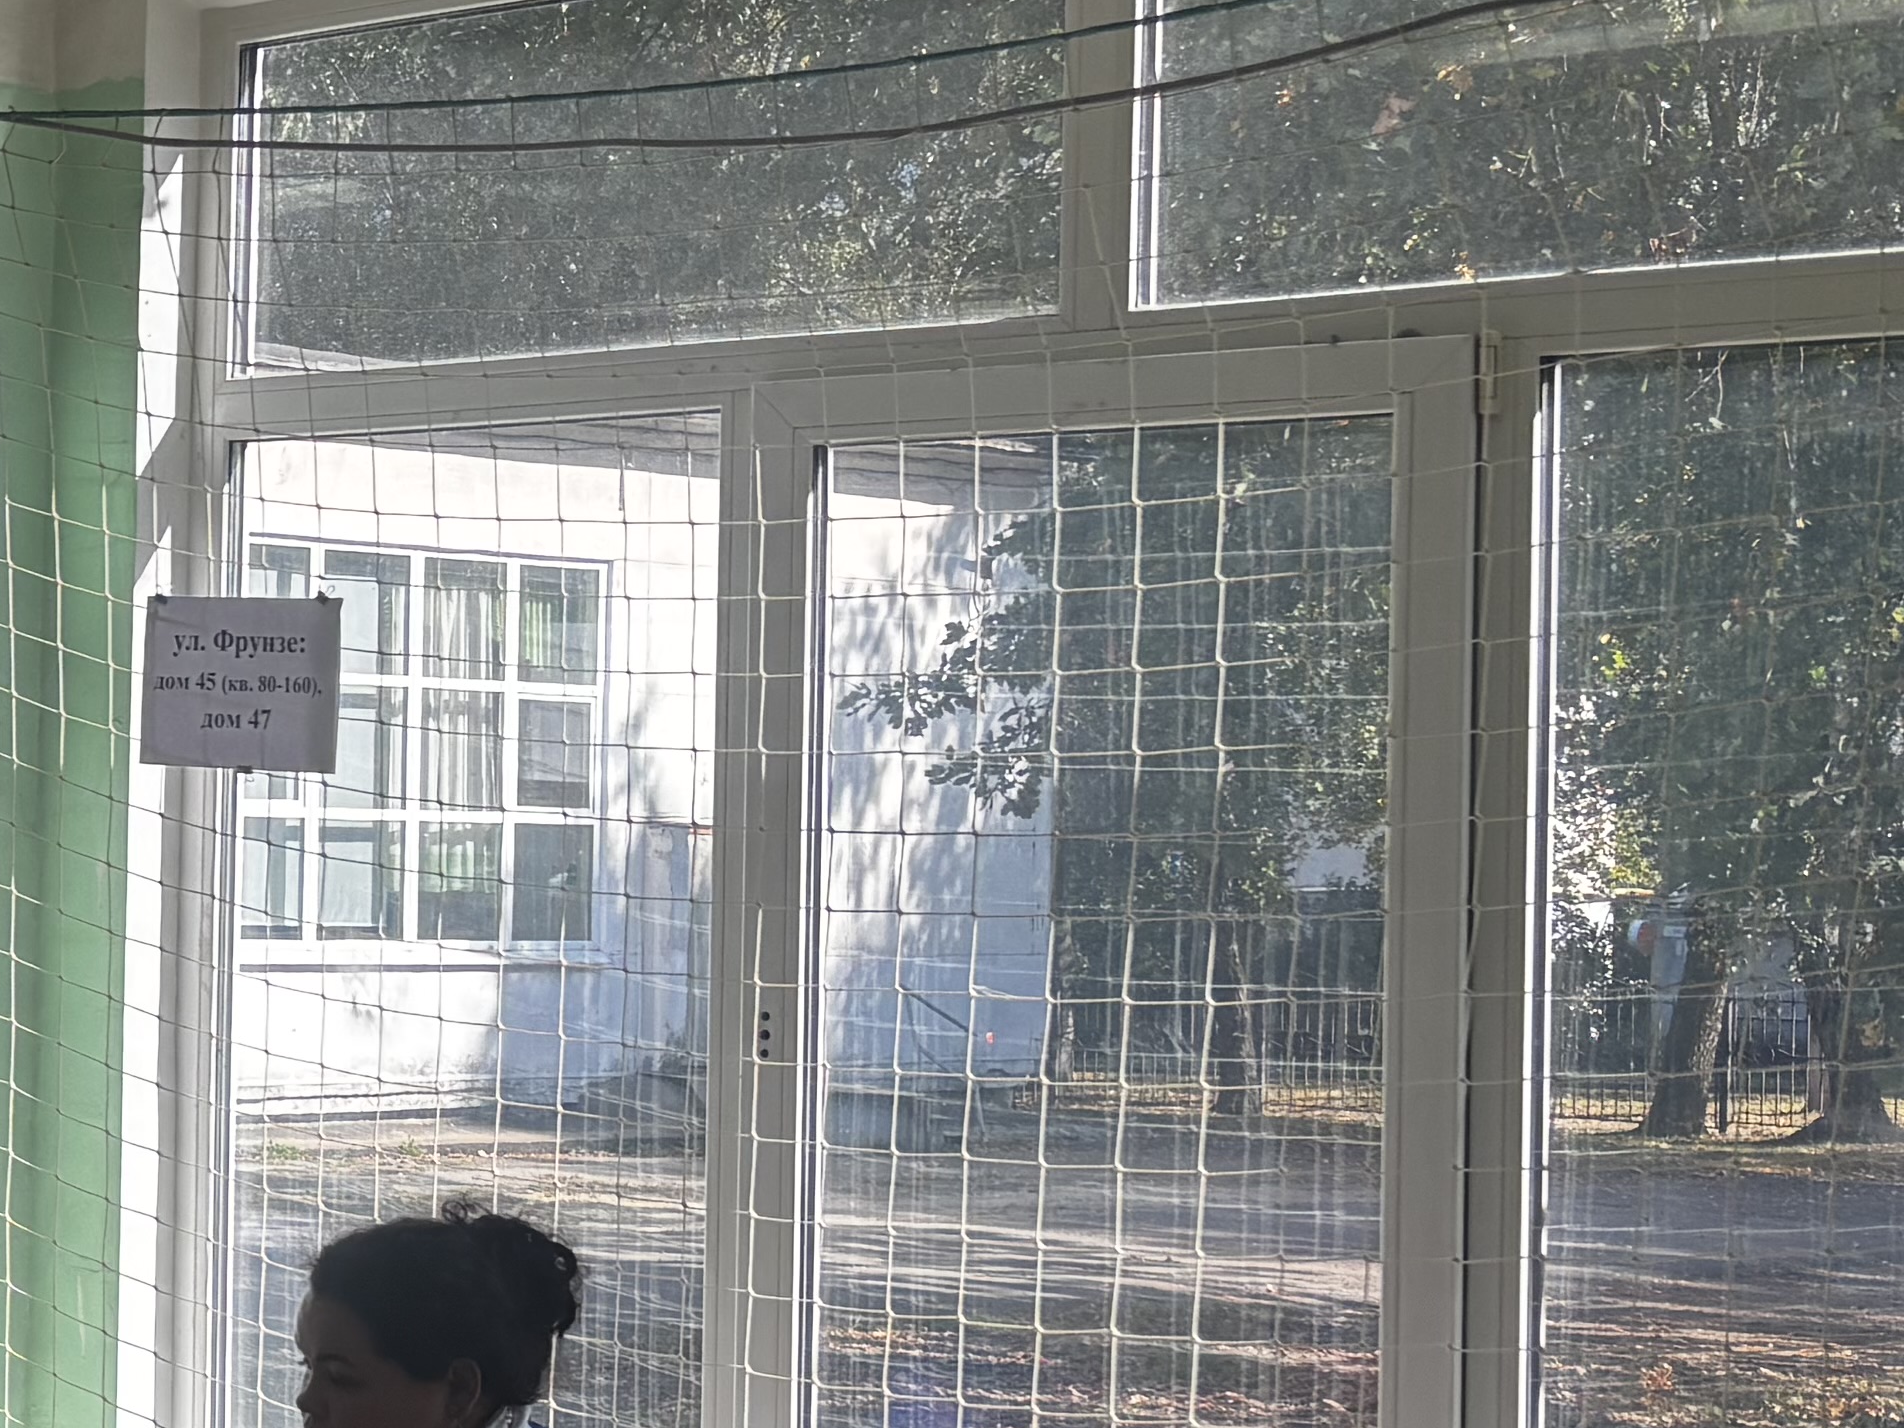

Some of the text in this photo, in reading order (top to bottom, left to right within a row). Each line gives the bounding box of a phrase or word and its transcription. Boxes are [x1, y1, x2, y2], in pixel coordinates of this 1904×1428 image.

[173, 629, 306, 658] ул. Фрунзе:
[153, 675, 190, 692] дом
[195, 671, 216, 691] 45
[222, 675, 253, 696] (кв.
[200, 708, 272, 730] дом 47
